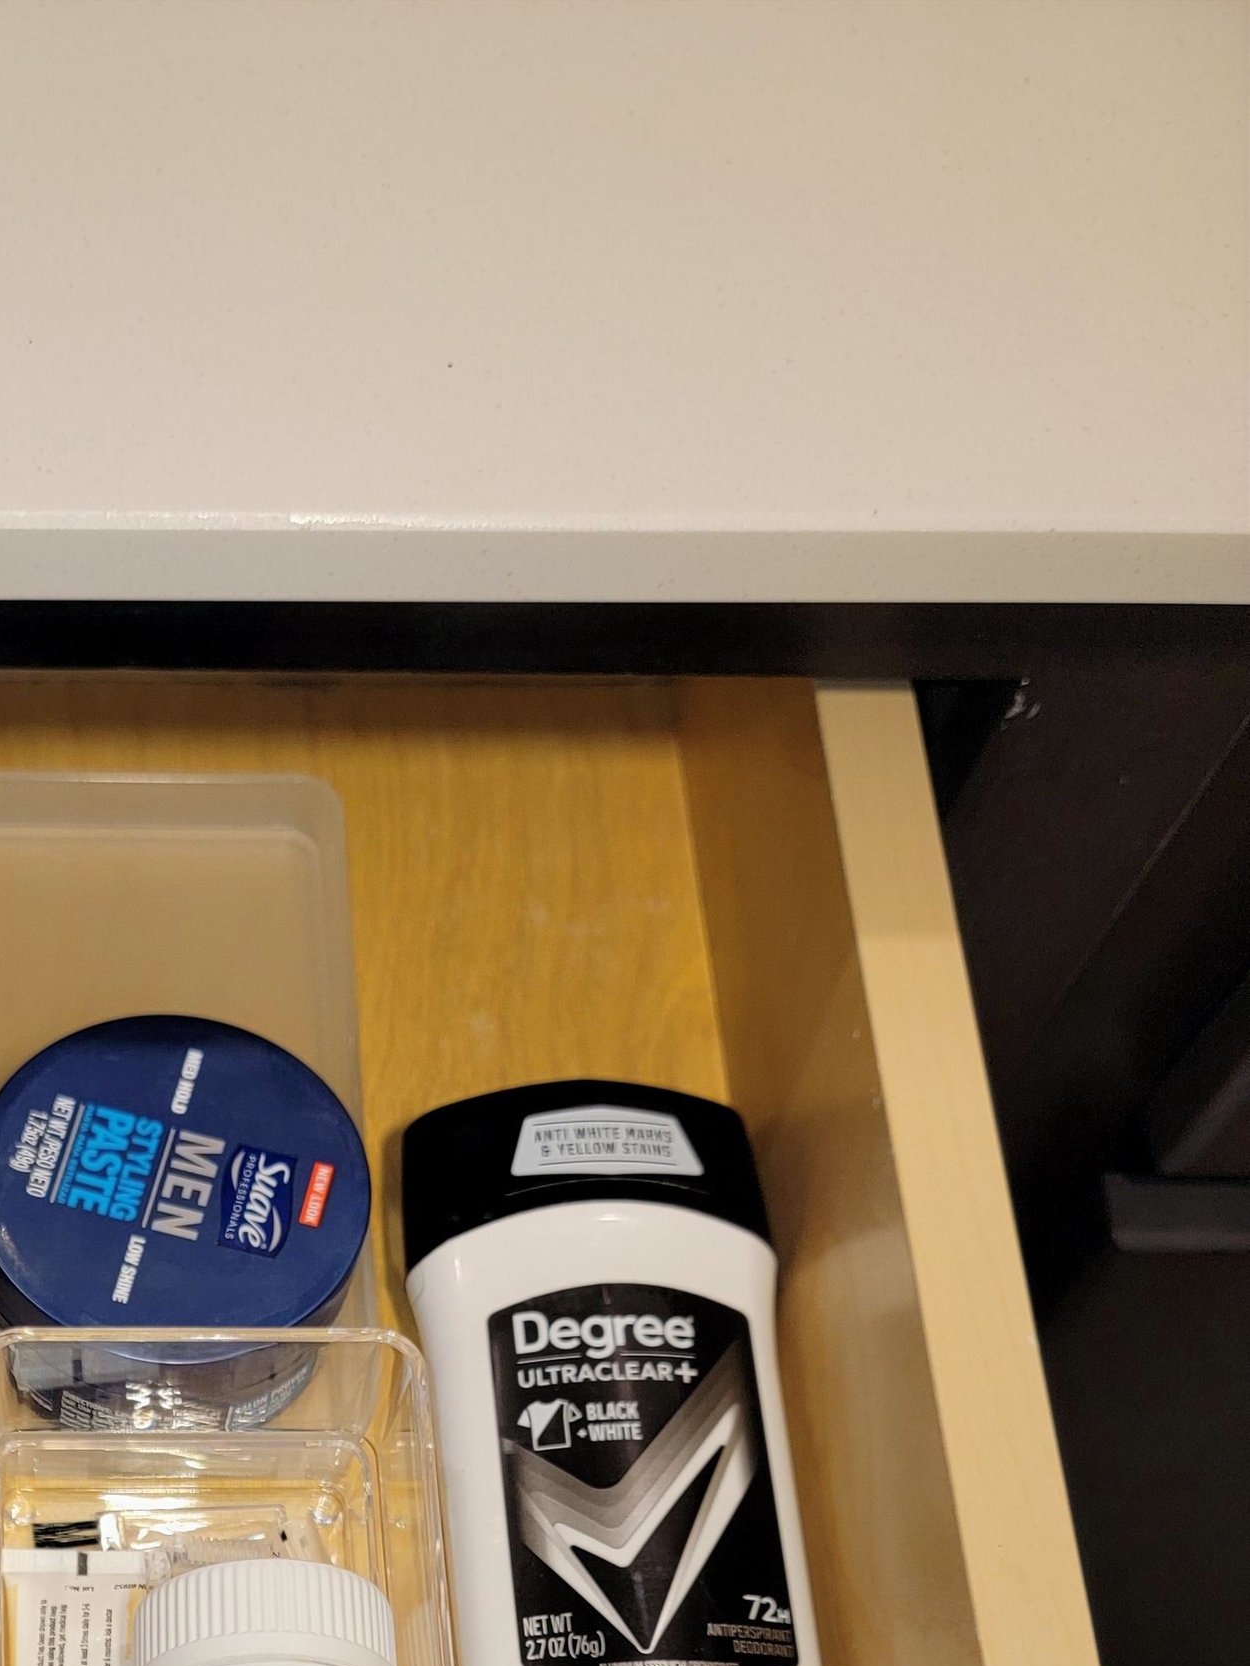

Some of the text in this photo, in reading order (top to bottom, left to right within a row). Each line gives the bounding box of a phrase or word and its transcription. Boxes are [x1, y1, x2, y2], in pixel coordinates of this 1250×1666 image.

[52, 1094, 76, 1121] NET
[534, 1127, 672, 1144] ANTI WHITE MARKS
[557, 1143, 615, 1156] YELLOW
[621, 1143, 672, 1158] STAINS
[25, 1166, 53, 1199] NETO
[67, 1105, 136, 1217] PASTE
[110, 1116, 164, 1222] STYLING
[150, 1130, 226, 1241] MEN
[224, 1152, 257, 1240] PROFESSIONALS
[238, 1152, 291, 1249] Suave
[305, 1165, 332, 1222] NEW LOOK
[111, 1235, 148, 1305] LOW SHINE
[512, 1310, 697, 1360] Degree
[585, 1401, 640, 1421] BLACK
[522, 1611, 573, 1638] NET WT
[548, 1636, 567, 1658] OZ
[567, 1630, 606, 1660] (76g)
